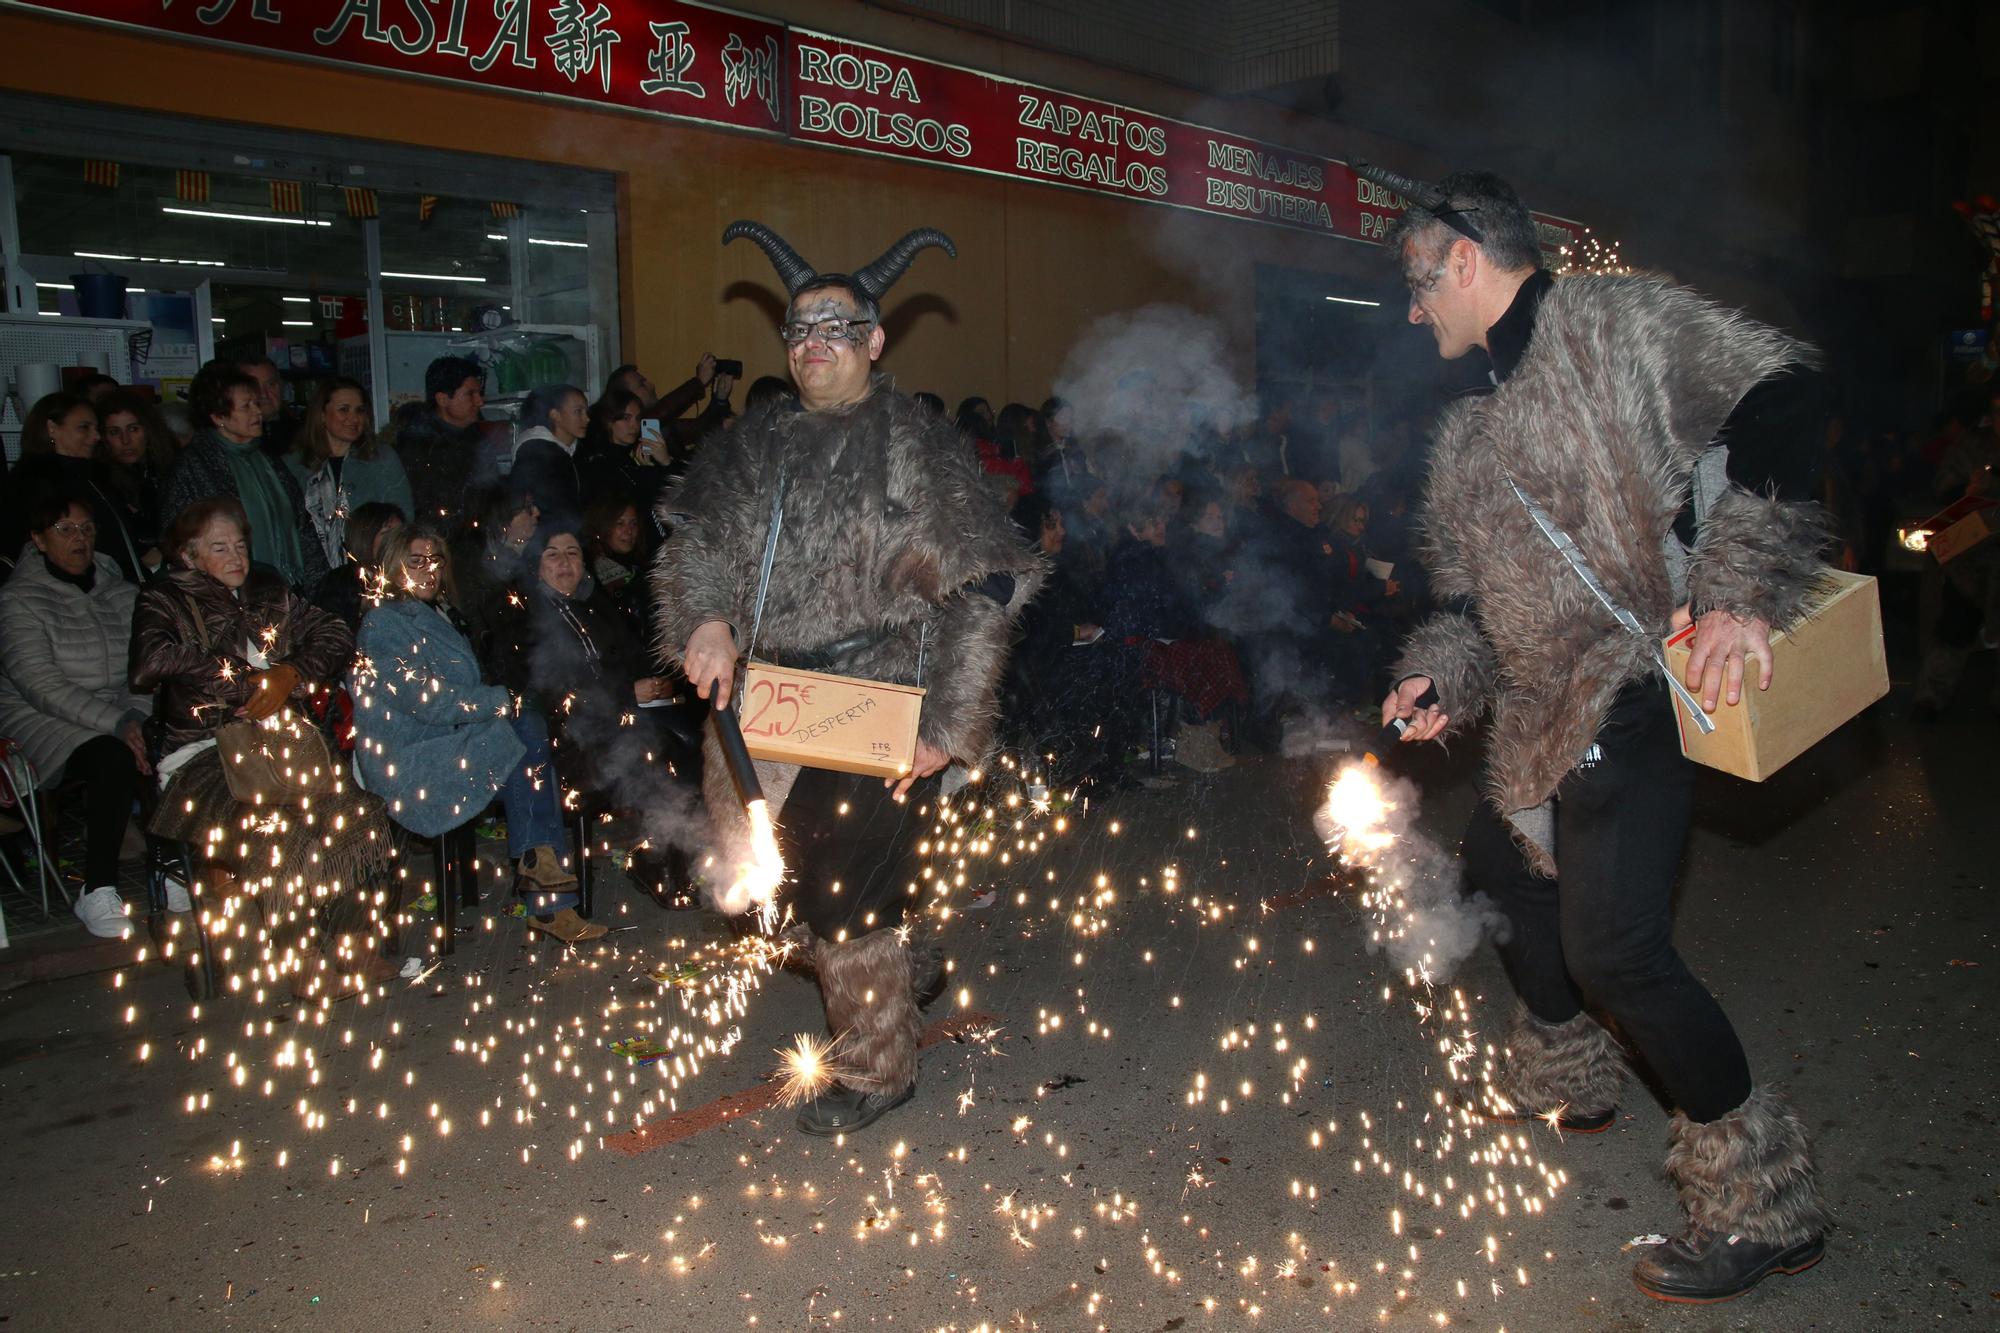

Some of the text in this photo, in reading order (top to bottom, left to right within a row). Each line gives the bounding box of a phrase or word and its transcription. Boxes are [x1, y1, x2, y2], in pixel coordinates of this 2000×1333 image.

[313, 0, 537, 69] ASIA
[544, 0, 779, 122] 新亚洲
[798, 45, 920, 103] ROPA
[798, 95, 972, 157] BOLSOS
[1018, 95, 1167, 155] ZAPATOS
[1016, 137, 1169, 196] REGALOS
[1207, 140, 1325, 192] MENAJES
[1206, 176, 1333, 229] BISUTERIA
[743, 680, 816, 737] 25€
